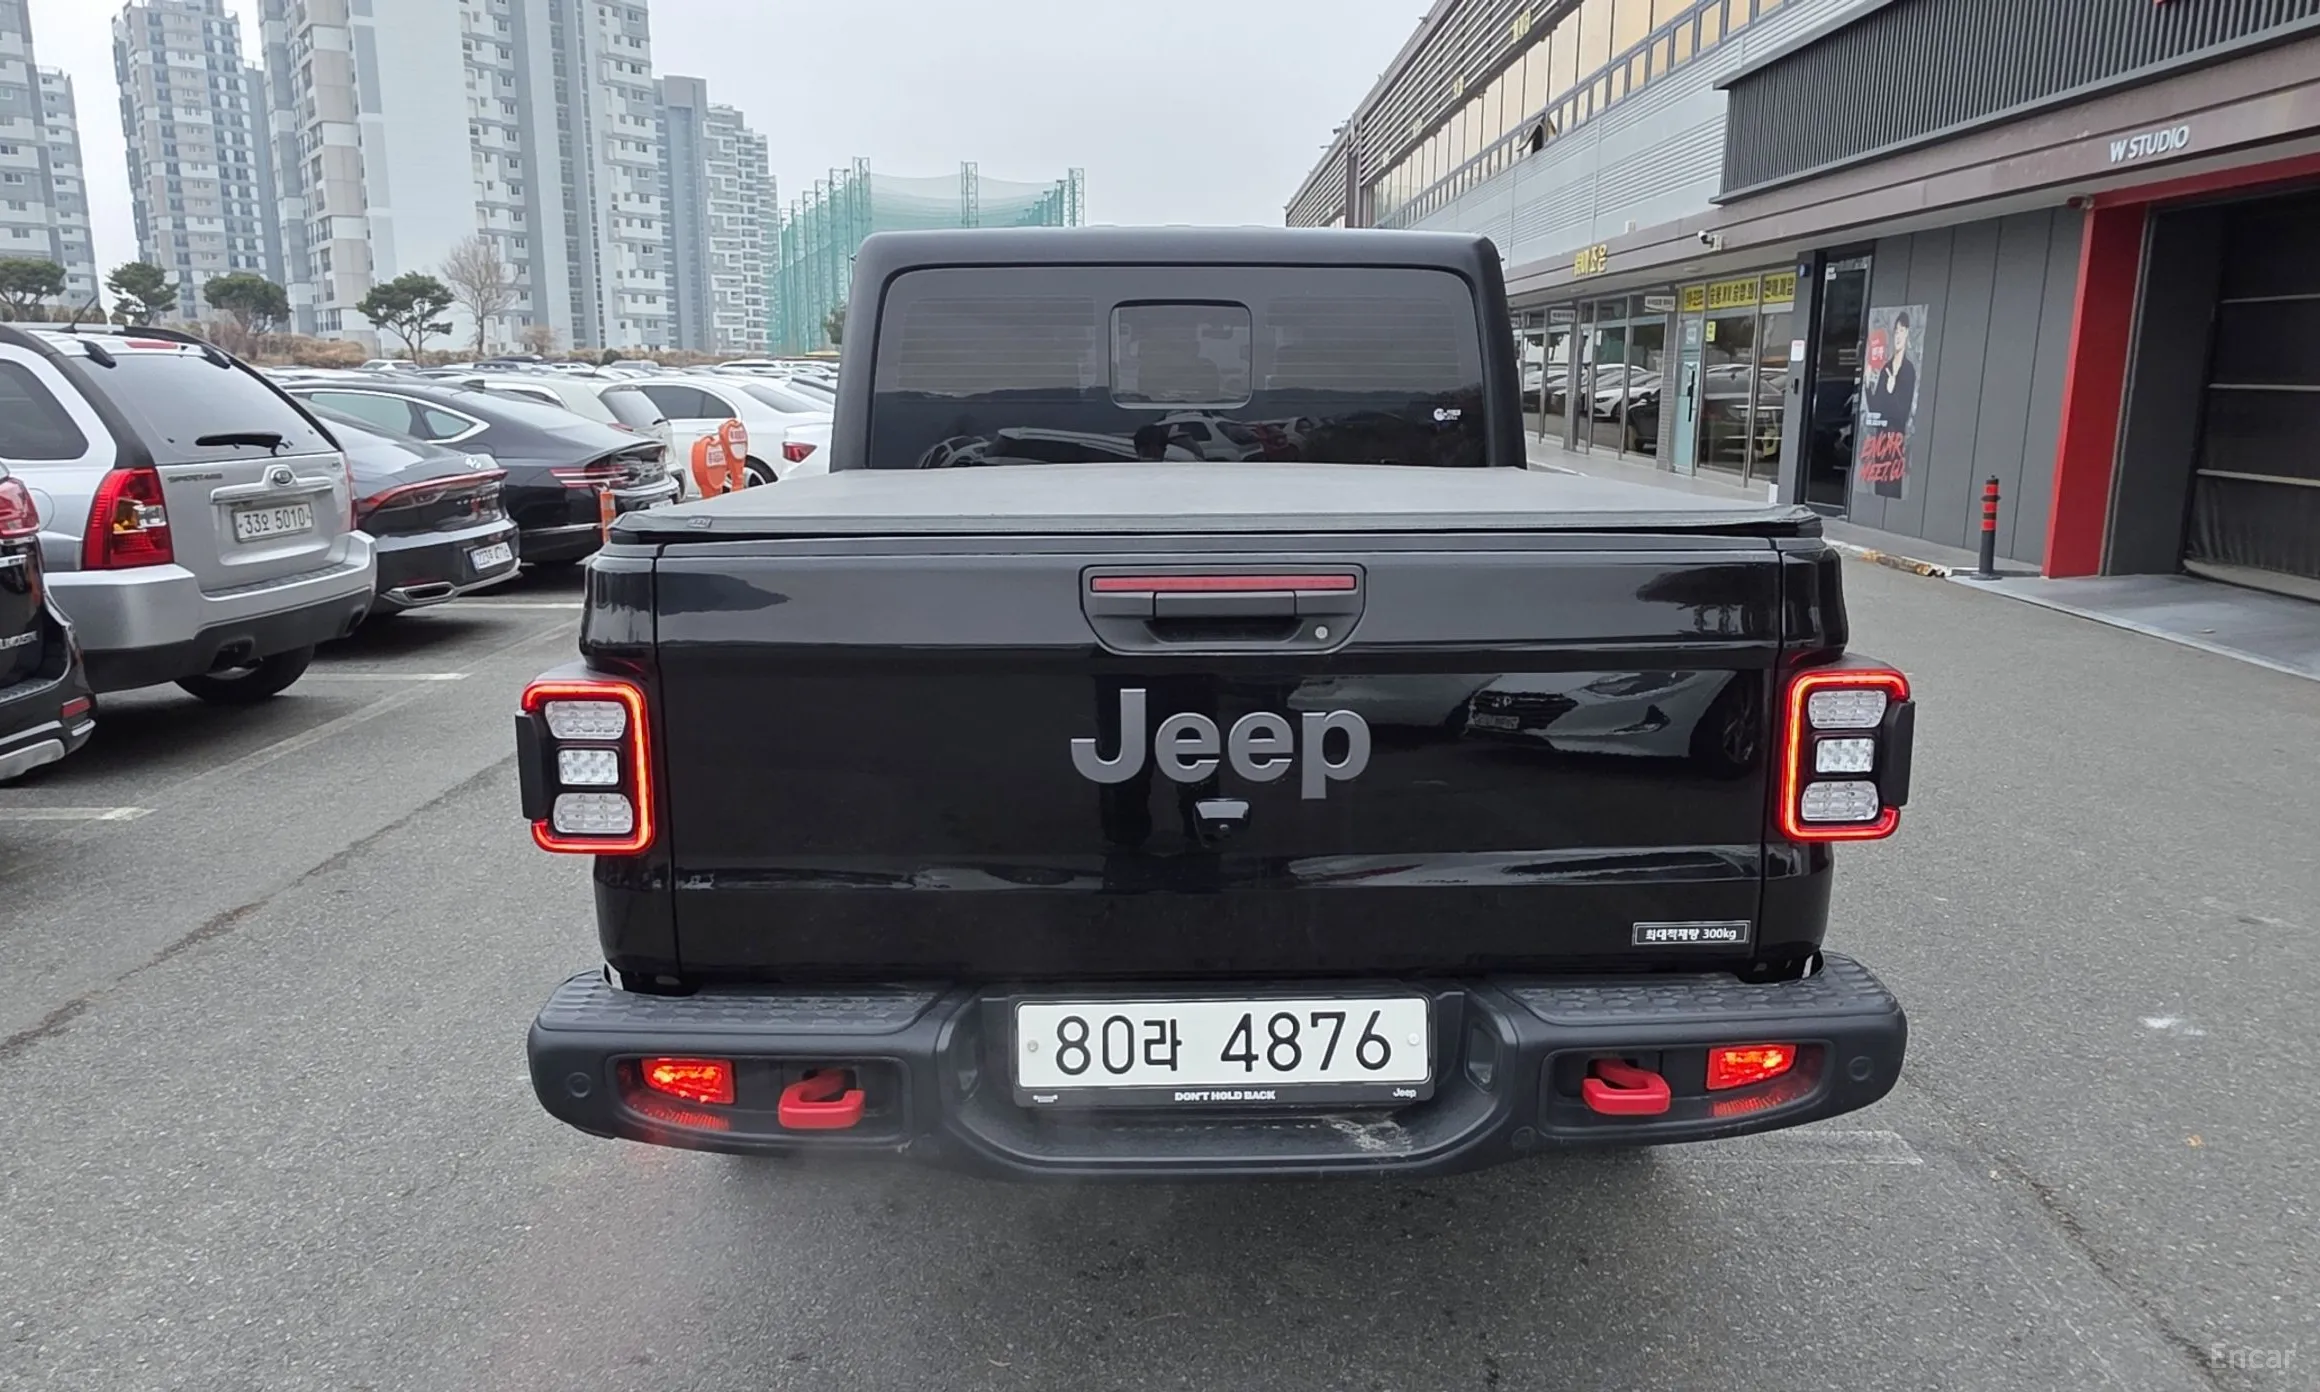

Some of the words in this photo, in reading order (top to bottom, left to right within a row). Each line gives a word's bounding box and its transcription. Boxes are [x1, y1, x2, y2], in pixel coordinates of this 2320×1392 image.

[2110, 139, 2128, 163] W
[2128, 125, 2190, 160] STUDIO
[244, 513, 271, 534] 33오
[276, 507, 306, 530] 5010
[1070, 688, 1371, 799] Jeep
[1645, 927, 1700, 941] 최대적재량
[1702, 927, 1737, 940] 300kg
[1055, 1014, 1182, 1076] 80라
[1219, 1010, 1392, 1073] 4876
[1174, 1091, 1210, 1102] DON'T
[1211, 1090, 1242, 1101] HOLD
[1243, 1089, 1276, 1101] BACK
[1393, 1088, 1418, 1099] Jeep
